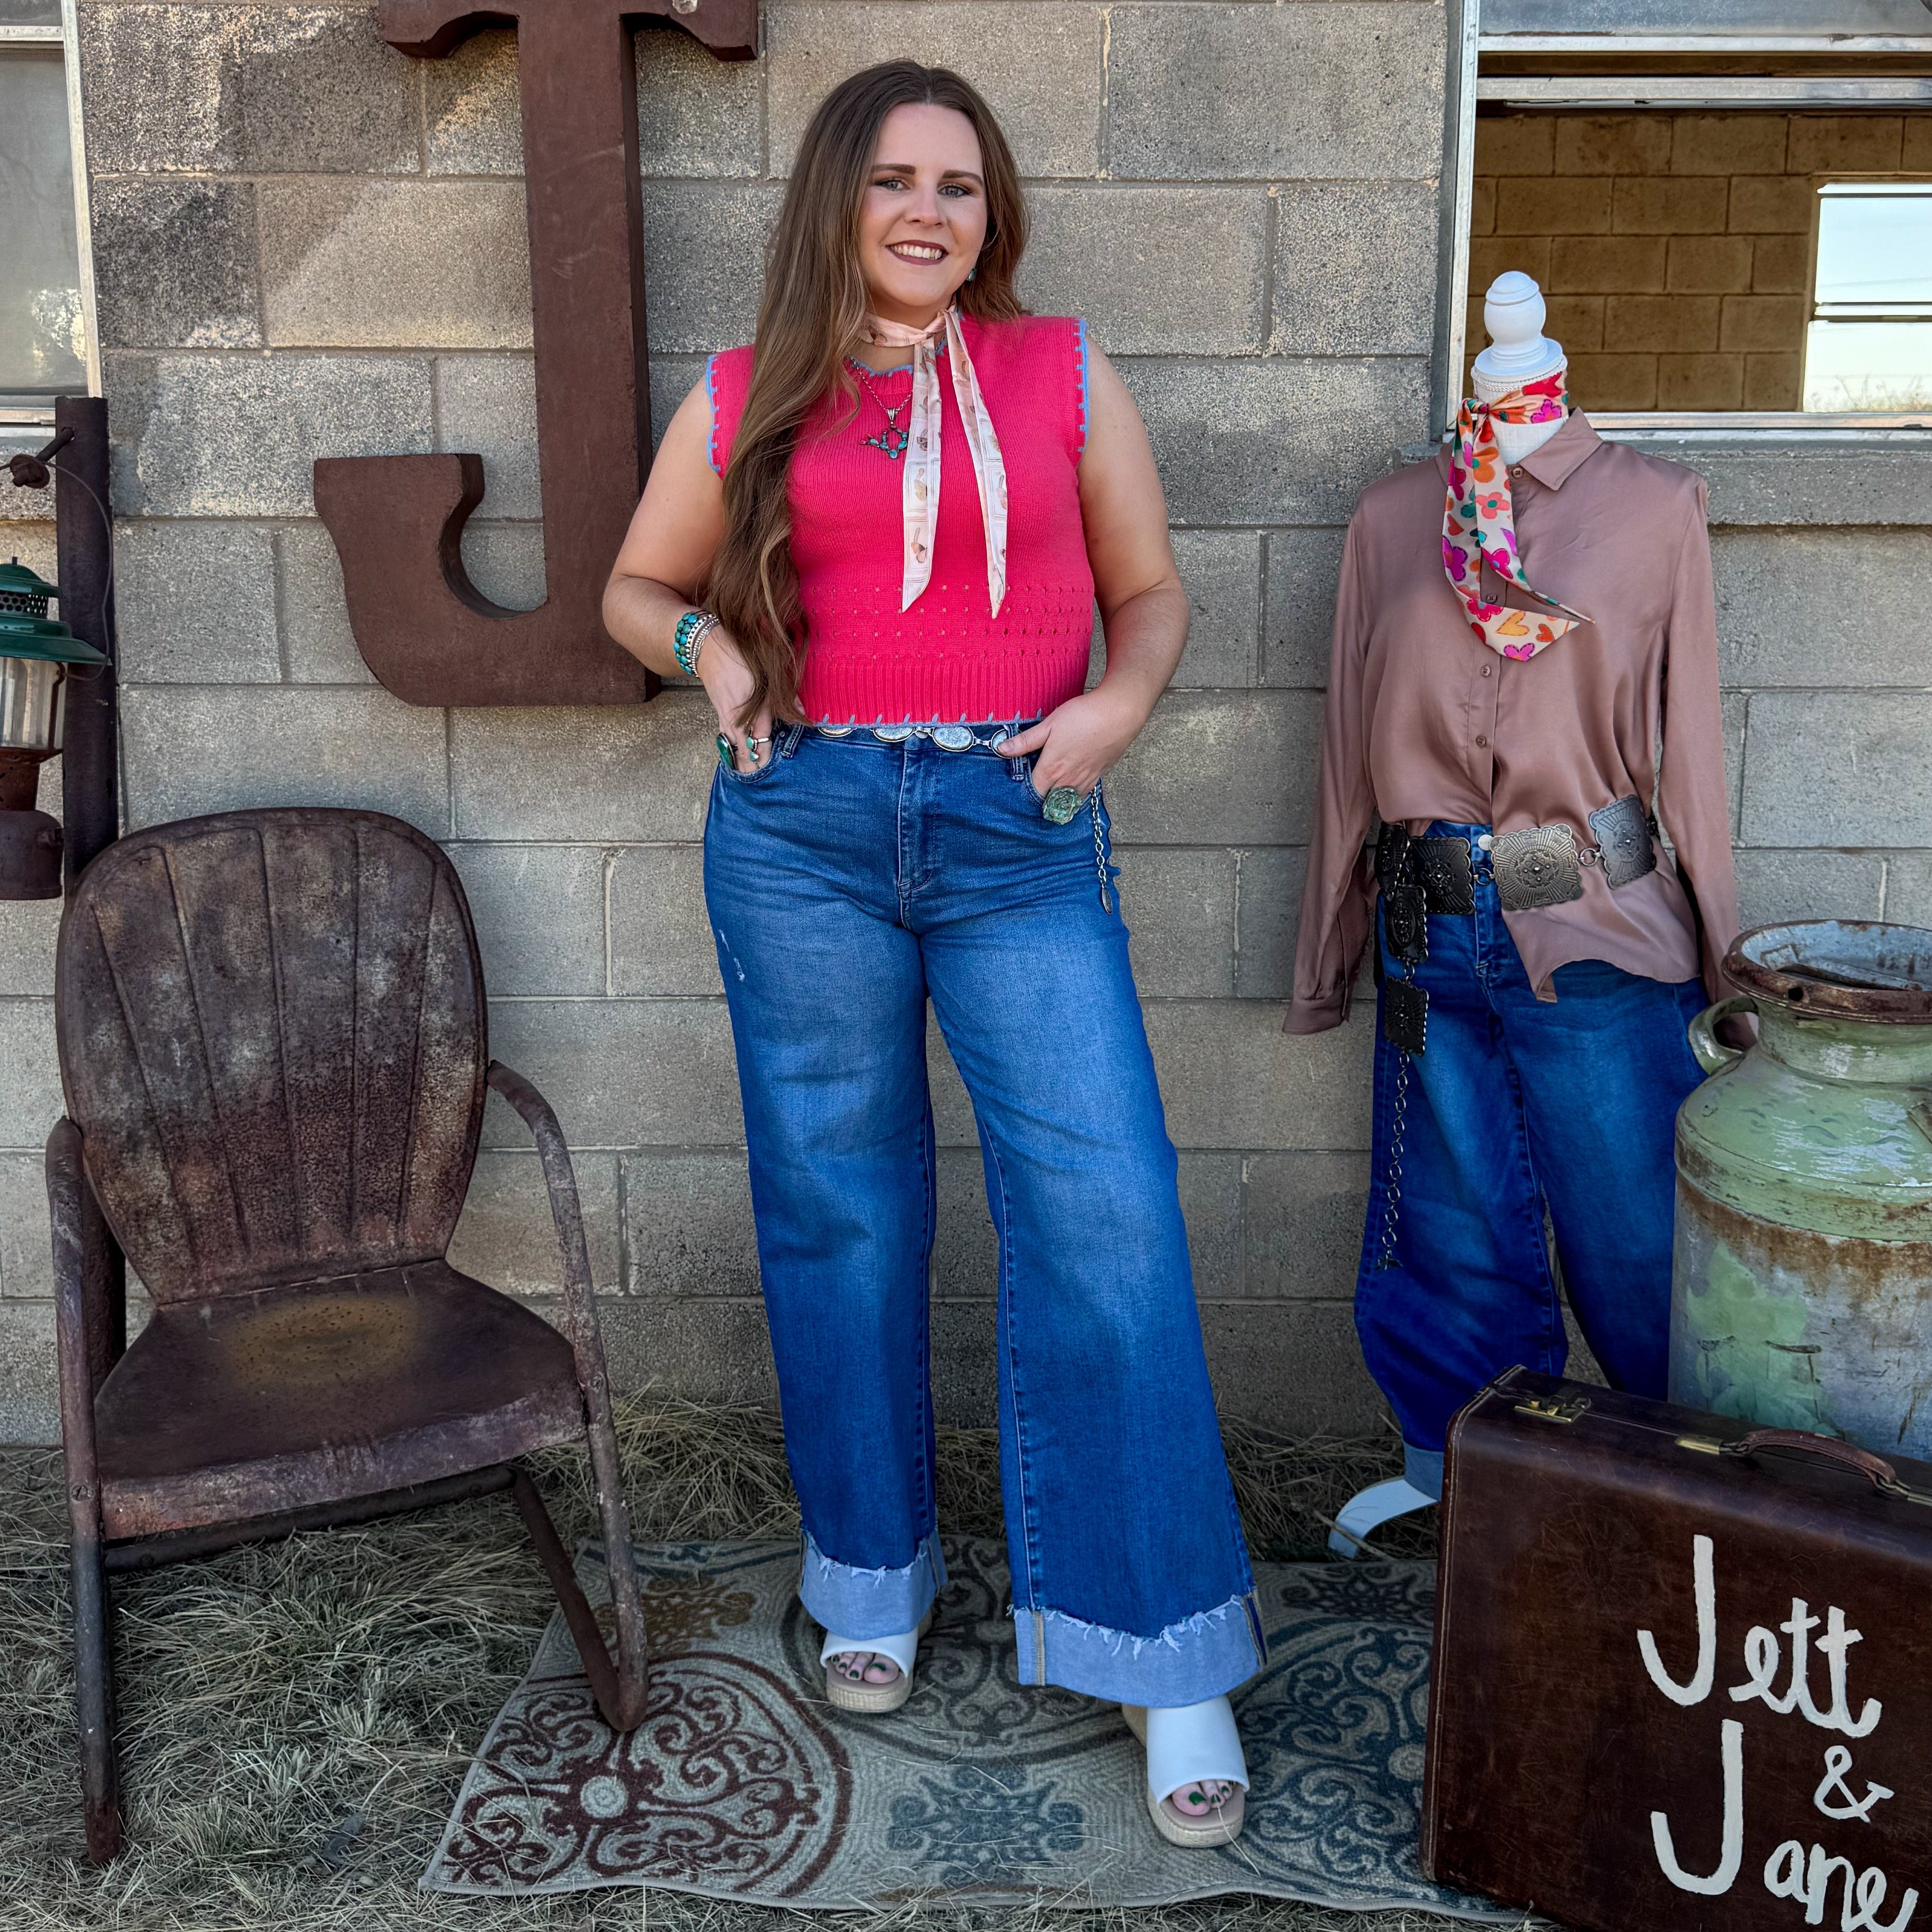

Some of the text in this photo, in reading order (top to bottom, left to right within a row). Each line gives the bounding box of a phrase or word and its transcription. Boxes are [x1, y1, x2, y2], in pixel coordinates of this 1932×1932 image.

[314, 0, 758, 707] J
[1637, 1534, 1882, 1738] Jett
[1650, 1719, 1920, 1932] Jane
[1814, 1745, 1895, 1823] &
